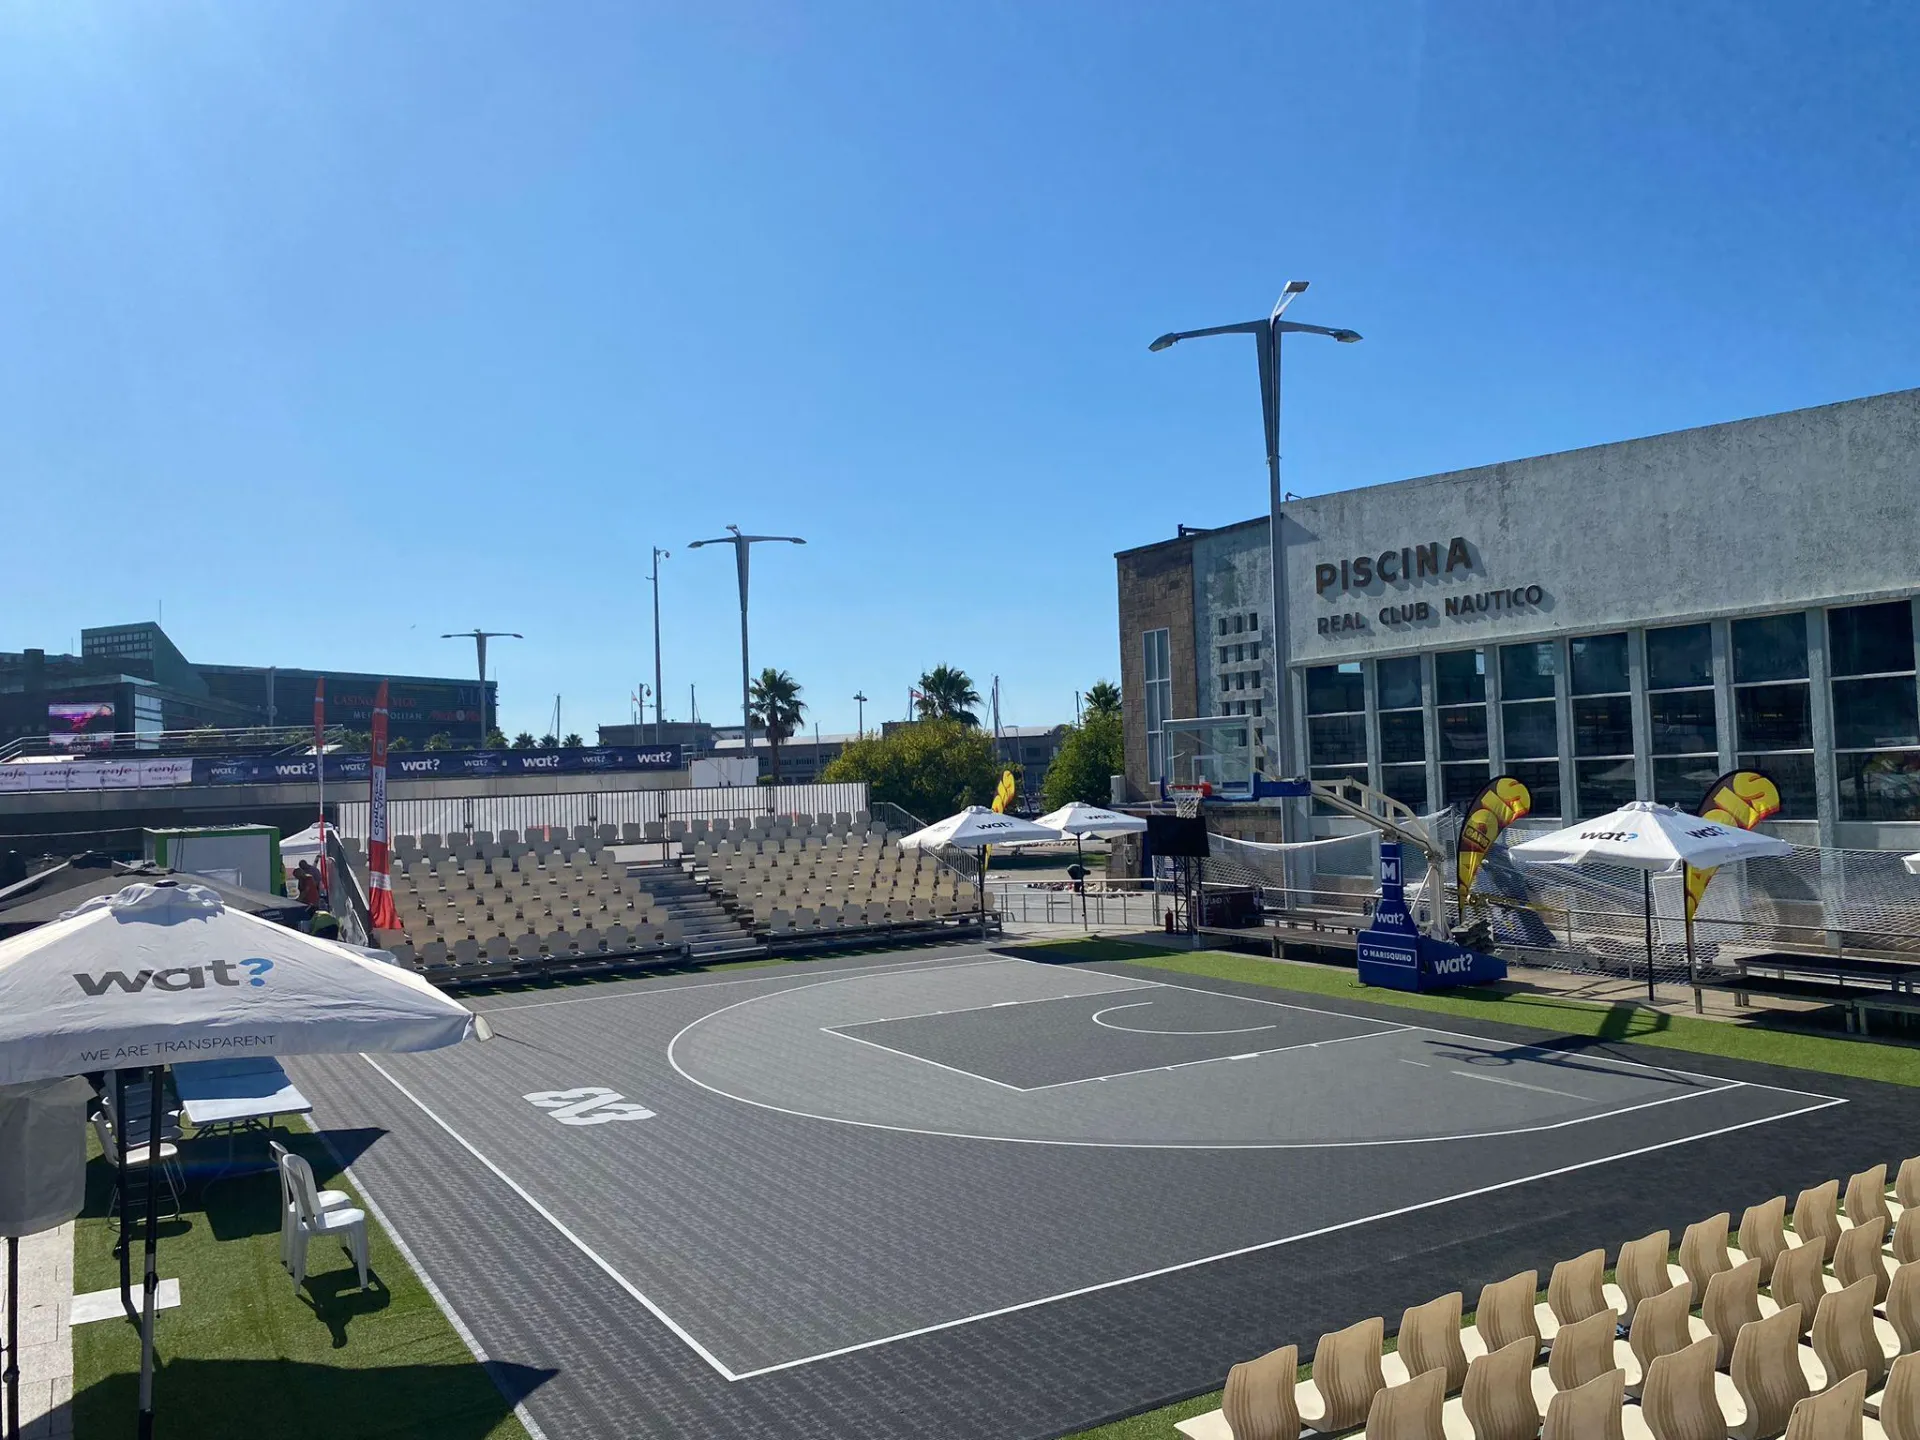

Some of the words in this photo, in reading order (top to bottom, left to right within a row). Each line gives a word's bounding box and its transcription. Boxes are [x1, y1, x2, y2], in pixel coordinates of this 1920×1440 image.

[1315, 537, 1473, 594] PISCINA
[1317, 611, 1366, 635] REAL
[1378, 602, 1430, 626] CLUB
[1445, 584, 1544, 617] NAUTICO
[401, 758, 440, 771] wat?
[522, 755, 559, 767] wat?
[637, 751, 672, 763] wat?
[275, 762, 316, 775] wat?
[1579, 830, 1639, 843] wat?
[1684, 824, 1730, 839] wat?
[1381, 861, 1397, 881] M
[1376, 912, 1405, 926] wat?
[1434, 953, 1474, 975] wat?
[72, 957, 274, 996] wat?
[80, 1050, 110, 1062] WE
[115, 1043, 149, 1058] ARE
[154, 1034, 276, 1054] TRANSPARENT
